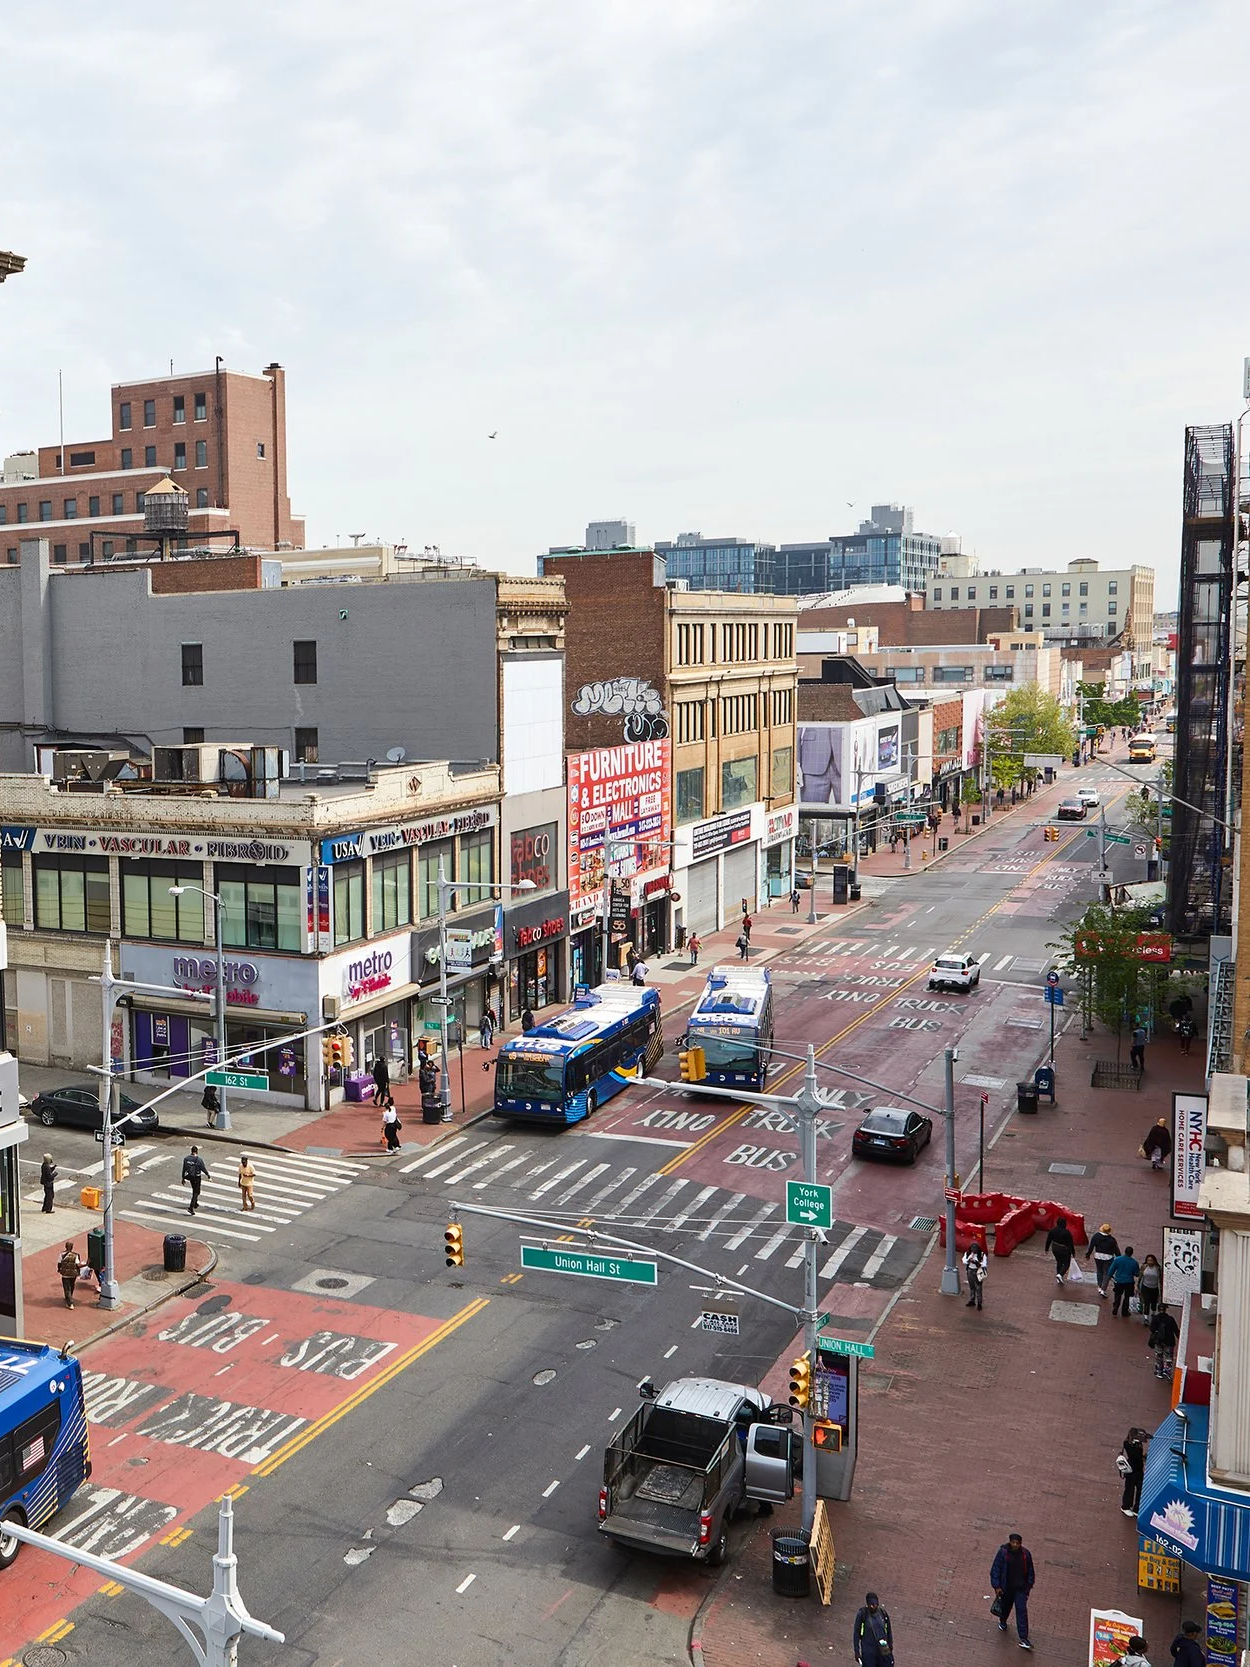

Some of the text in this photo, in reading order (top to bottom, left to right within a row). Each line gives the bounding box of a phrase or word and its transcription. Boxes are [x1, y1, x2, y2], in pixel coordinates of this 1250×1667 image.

[580, 741, 662, 783] FURNITURE
[581, 771, 661, 808] & ELECTRONICS
[612, 800, 633, 823] MALL
[44, 832, 289, 862] VEIN VASCULAR FIBROID
[334, 841, 355, 859] USA
[370, 831, 396, 850] VEIN
[401, 820, 449, 842] VASCULAR
[349, 951, 392, 981] metro
[894, 998, 968, 1015] TRUCK
[889, 1017, 944, 1032] BUS
[225, 1075, 248, 1087] 162 St
[633, 1109, 719, 1132] ONLY
[1189, 1111, 1203, 1152] NYHC
[723, 1144, 797, 1172] BUS
[1194, 1153, 1202, 1184] New York
[793, 1197, 824, 1211] College
[799, 1187, 818, 1198] York
[555, 1256, 621, 1276] Union Hall St
[157, 1311, 270, 1353] BUS
[280, 1331, 399, 1381] BUS
[819, 1338, 865, 1355] UNION HALL
[136, 1393, 314, 1465] TRUCK
[1155, 1533, 1183, 1558] 162-02
